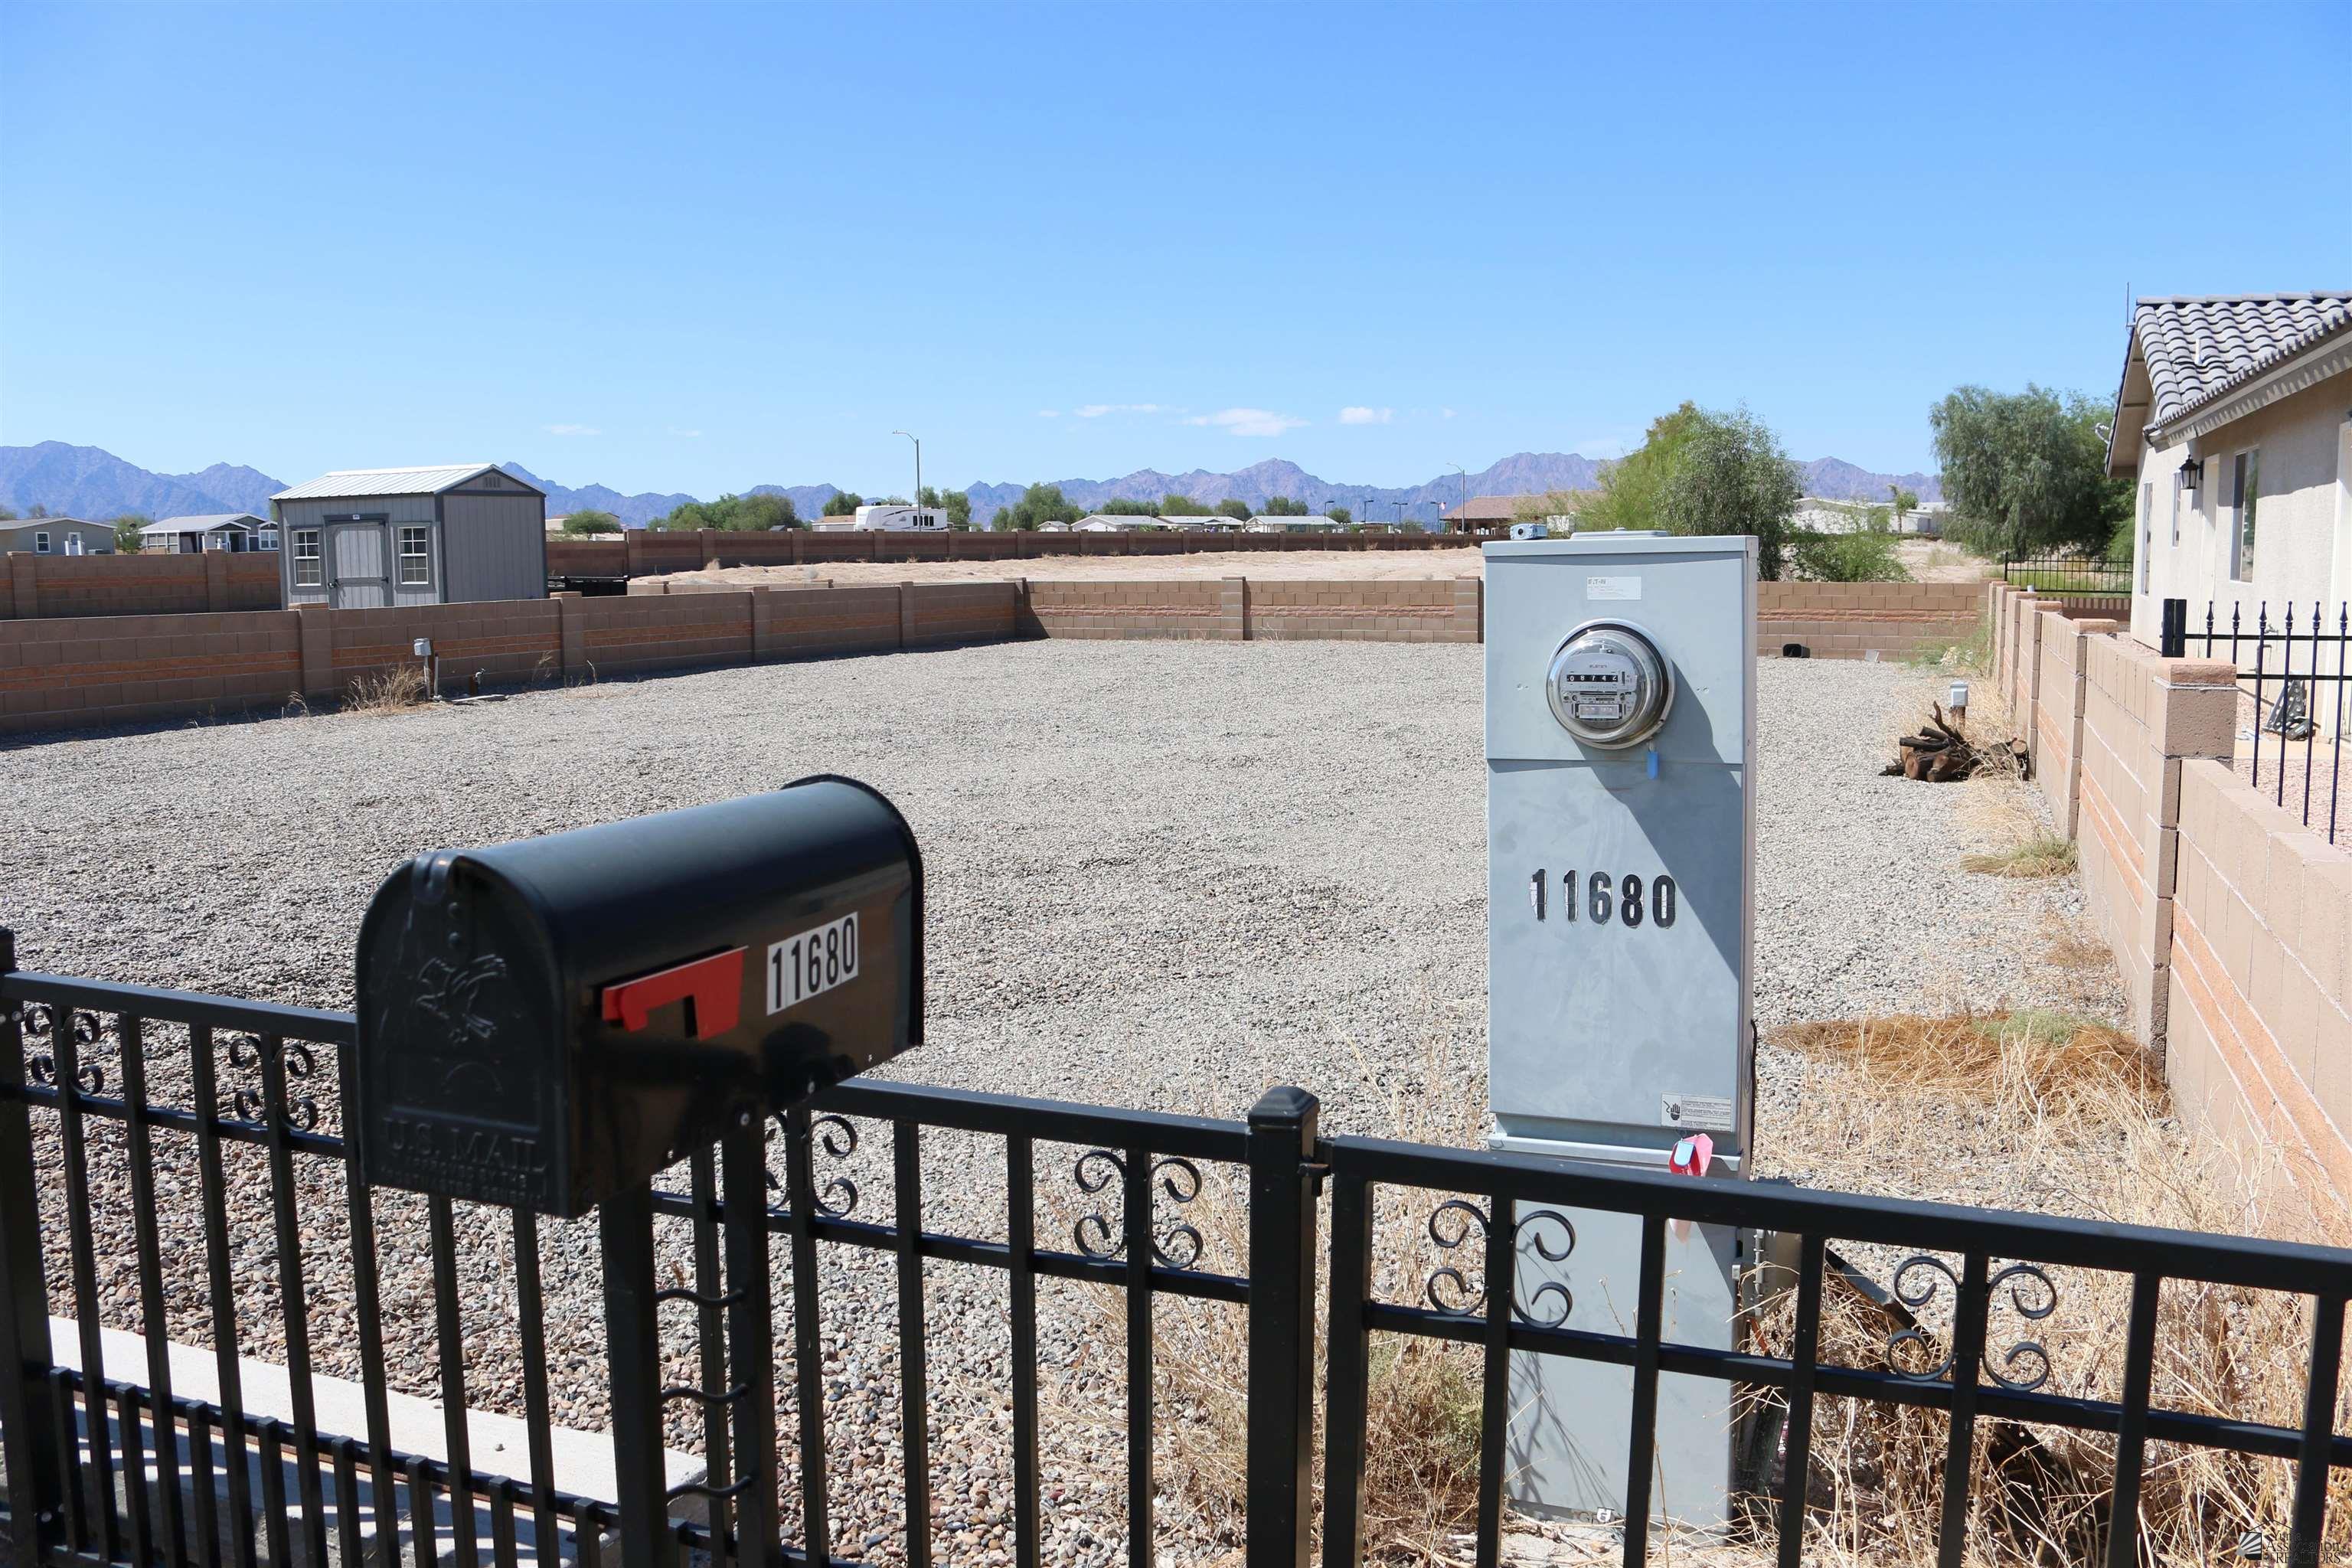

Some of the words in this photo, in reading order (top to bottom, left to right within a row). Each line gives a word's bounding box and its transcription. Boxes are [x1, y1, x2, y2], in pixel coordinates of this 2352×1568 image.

[1530, 868, 1677, 929] 11680
[772, 917, 855, 1009] 11680
[384, 1117, 441, 1155] U.S.
[450, 1128, 547, 1173] MAIL
